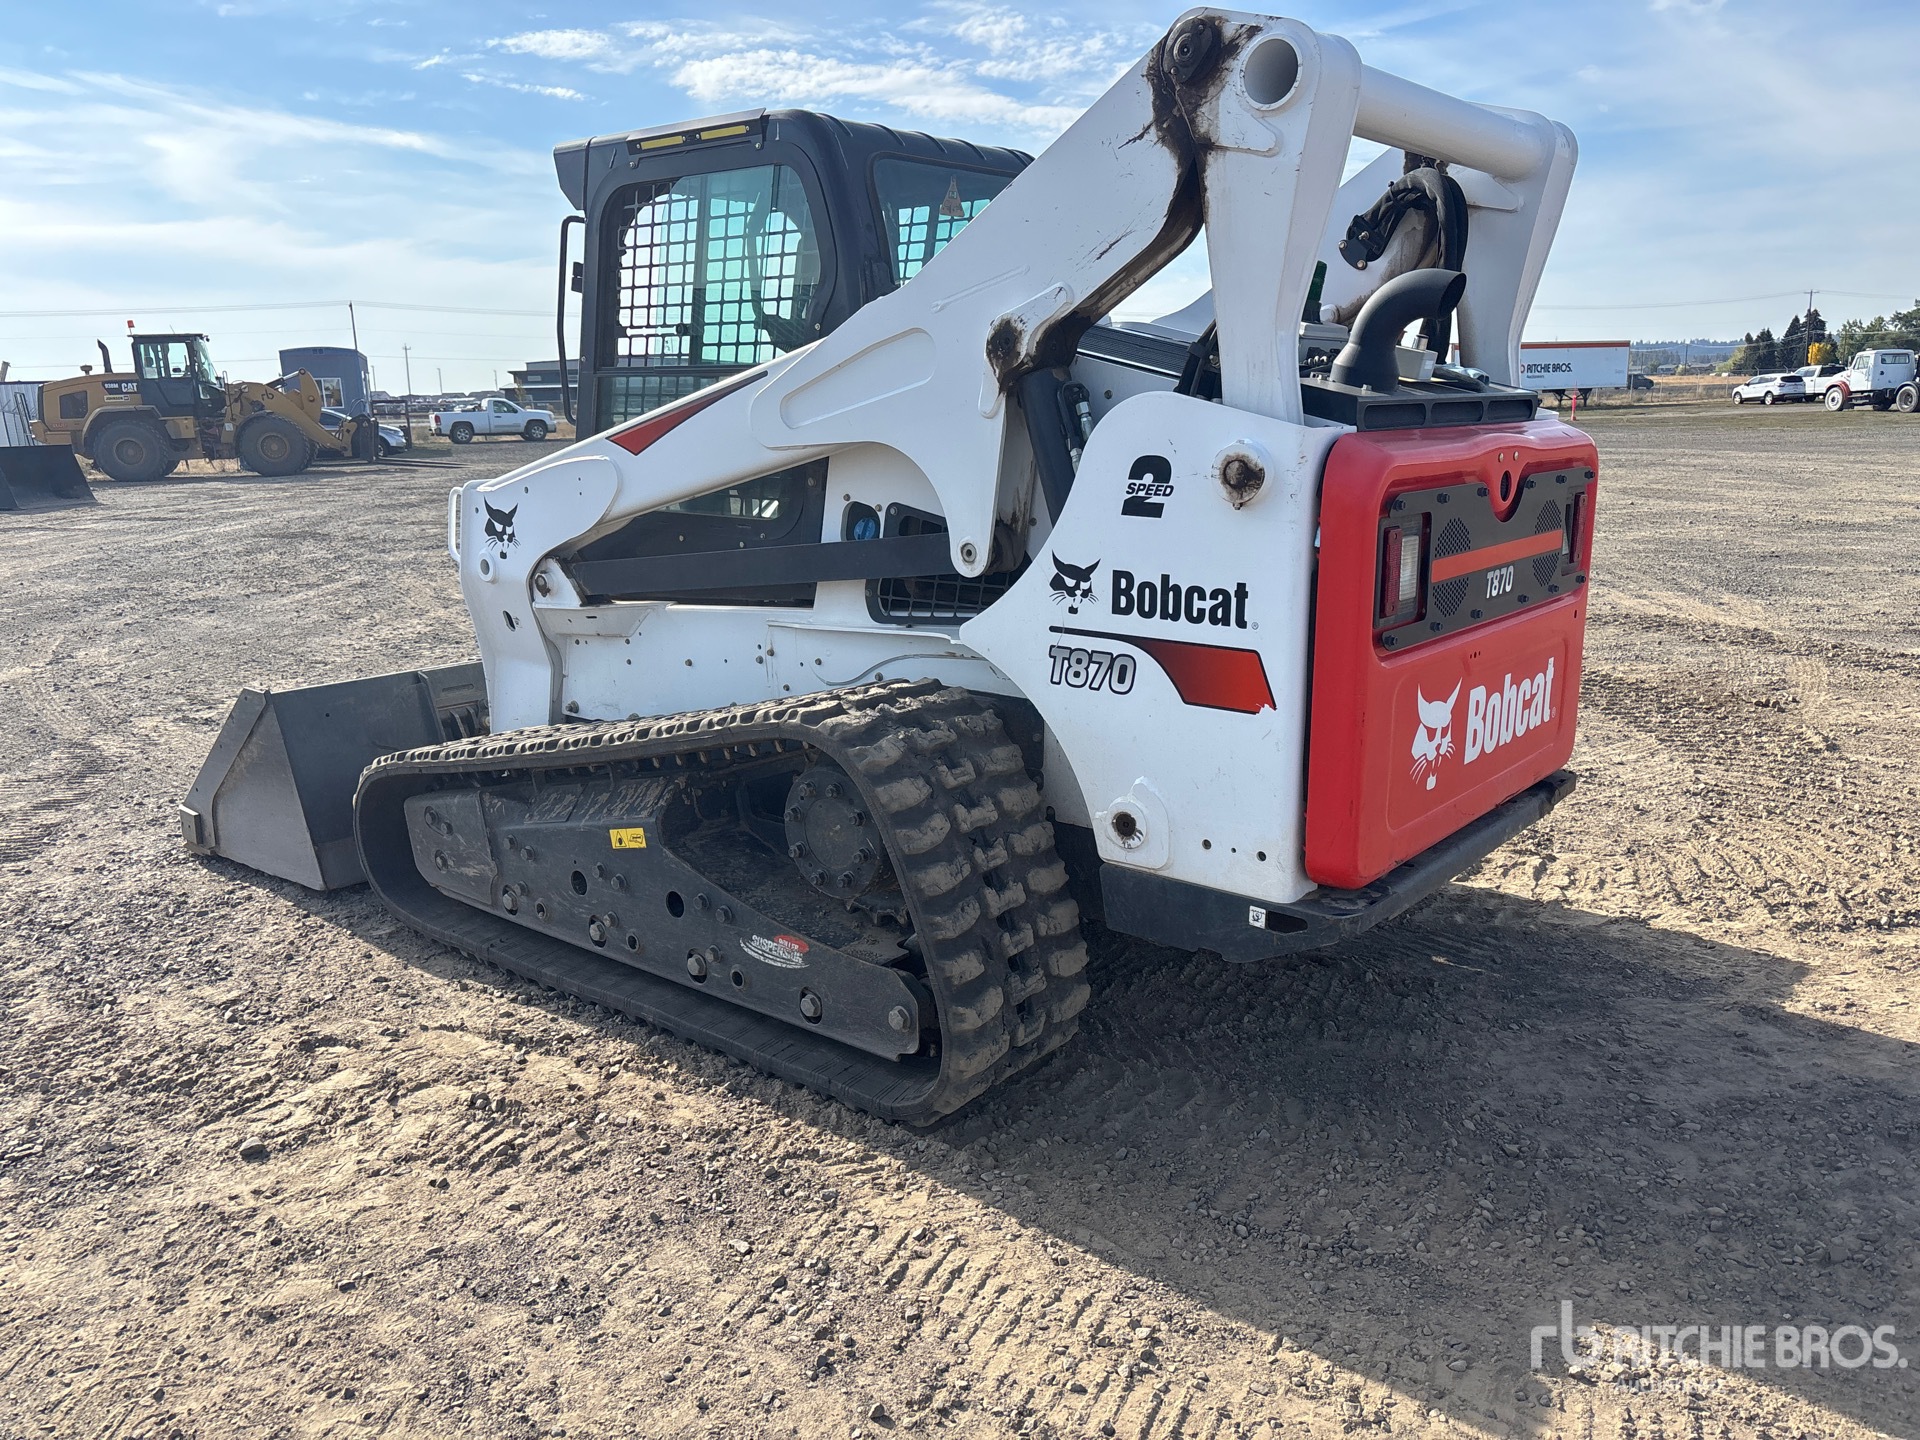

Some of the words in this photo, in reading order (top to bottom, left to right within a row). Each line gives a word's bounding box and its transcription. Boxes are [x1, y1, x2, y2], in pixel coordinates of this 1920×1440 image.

[121, 382, 138, 392] CAT
[1526, 363, 1551, 373] RITCHIE
[1121, 455, 1172, 518] 2
[1126, 482, 1174, 497] SPEED
[1112, 569, 1249, 629] Bobcat
[1486, 565, 1514, 599] T870
[1049, 645, 1137, 695] T870
[1464, 657, 1554, 765] Bobcat
